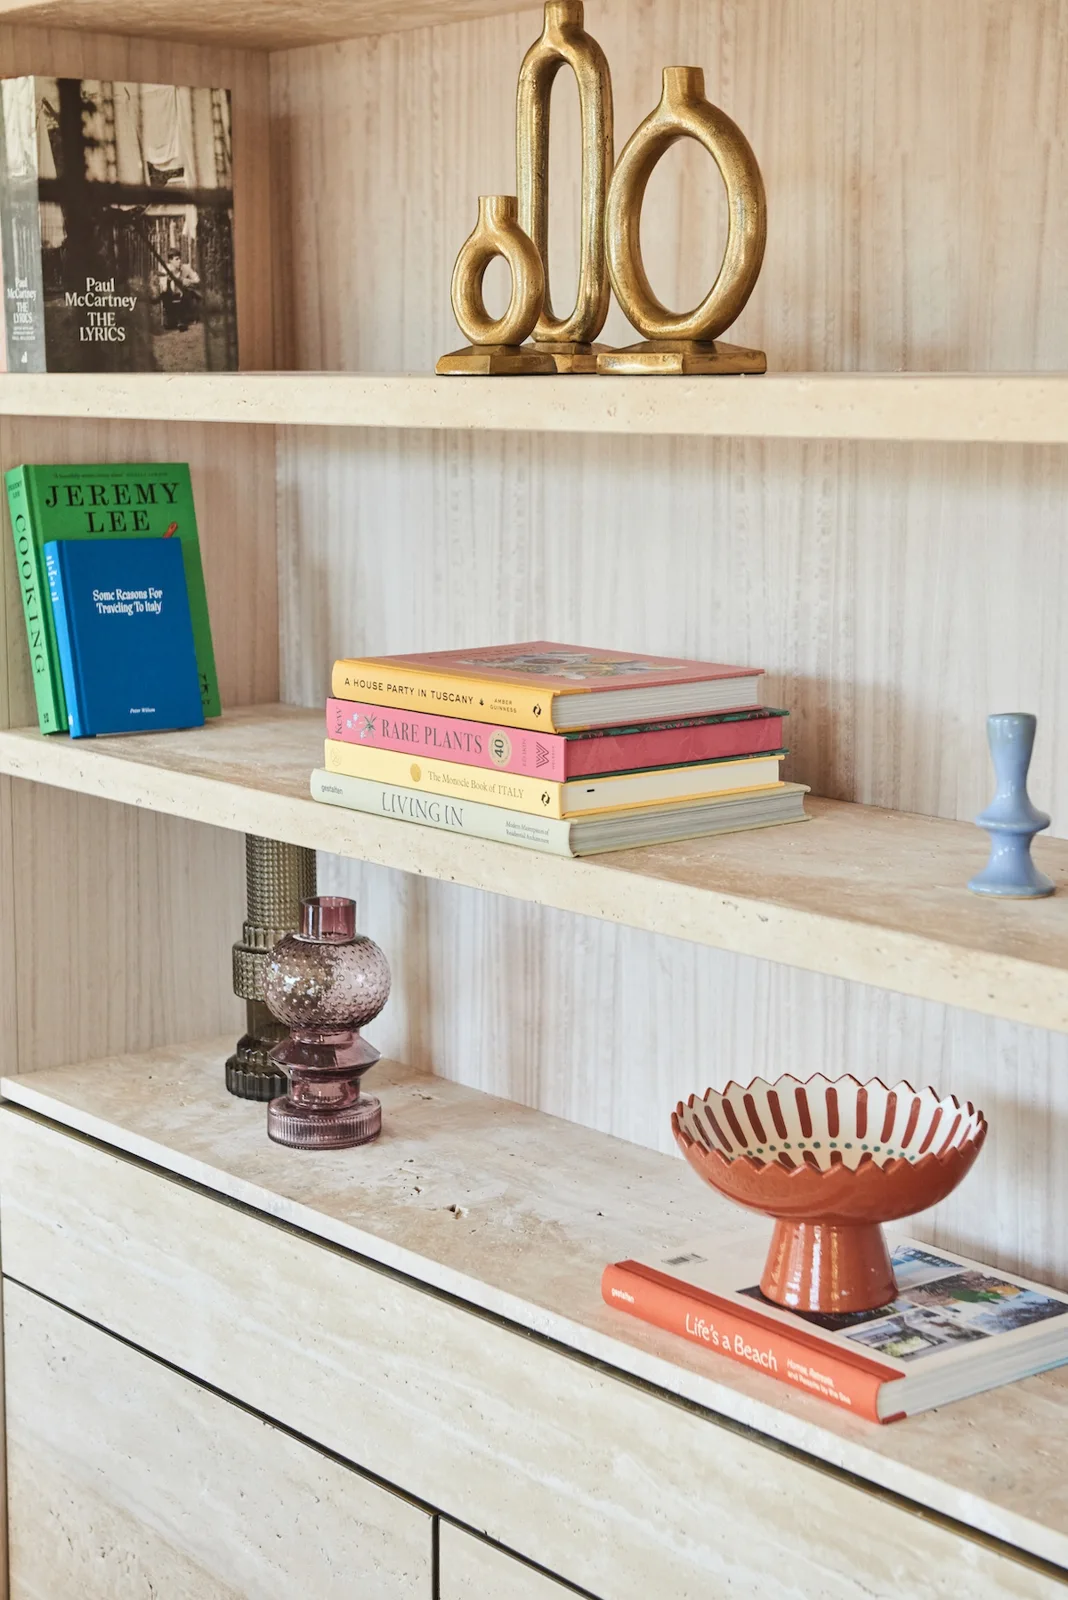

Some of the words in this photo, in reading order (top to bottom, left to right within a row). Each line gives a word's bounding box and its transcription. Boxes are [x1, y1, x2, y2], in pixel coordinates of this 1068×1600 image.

[86, 277, 115, 292] Paul
[16, 302, 29, 313] THE
[65, 292, 137, 311] McCartney
[87, 312, 116, 326] THE
[80, 327, 126, 341] LYRICS
[45, 482, 180, 508] JEREMY
[84, 509, 151, 533] LEE
[15, 514, 46, 674] COOKING
[92, 589, 115, 601] Some
[116, 588, 147, 601] Reasons
[148, 587, 163, 599] For
[96, 602, 134, 616] Traveling
[133, 601, 144, 612] To
[145, 600, 162, 614] Italy
[344, 677, 351, 686] A
[353, 679, 384, 691] HOUSE
[386, 684, 415, 696] PARTY
[417, 688, 428, 698] IN
[430, 690, 474, 705] TUSCANY
[489, 704, 518, 714] GUINNESS
[494, 698, 513, 706] AMBER
[382, 719, 420, 744] RARE
[424, 726, 483, 754] PLANTS
[494, 739, 505, 758] 40
[321, 784, 344, 796] gestalten
[428, 770, 441, 781] The
[441, 773, 470, 788] Monocle
[471, 779, 488, 793] Book
[488, 783, 497, 793] of
[498, 785, 525, 799] ITALY
[382, 792, 441, 822] LIVING
[445, 805, 464, 828] IN
[685, 1312, 720, 1347] Life's
[722, 1335, 732, 1352] a
[734, 1334, 778, 1372] Beach
